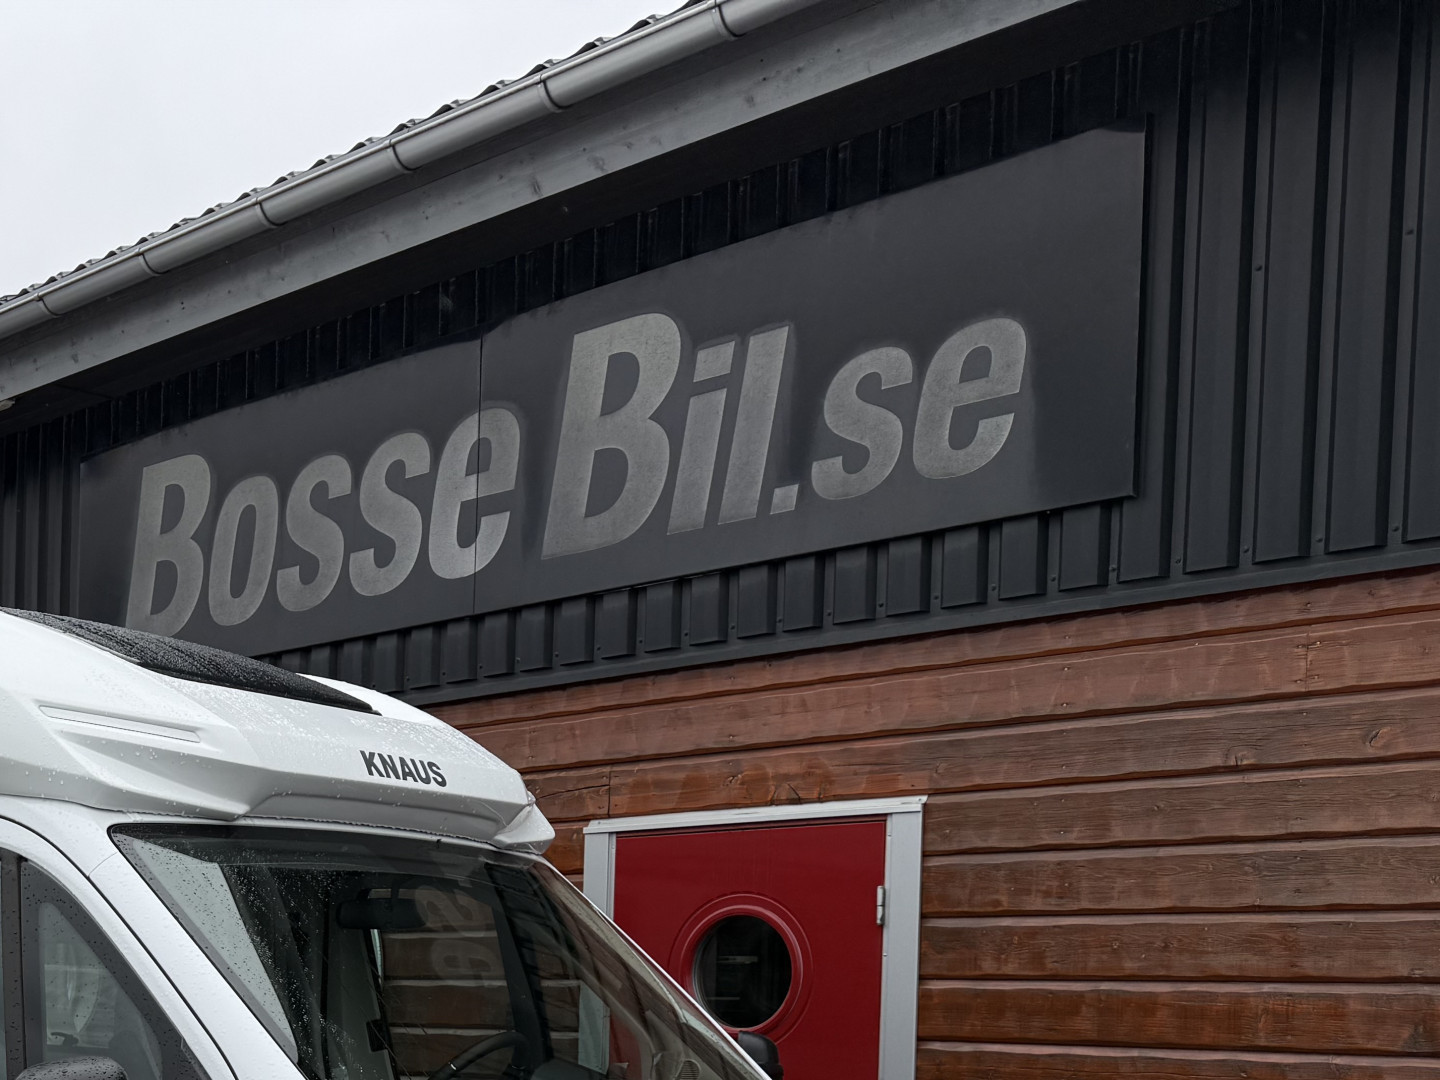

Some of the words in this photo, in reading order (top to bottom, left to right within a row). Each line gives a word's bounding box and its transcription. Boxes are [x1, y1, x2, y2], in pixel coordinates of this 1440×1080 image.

[124, 406, 522, 637] Bosse
[541, 311, 1028, 561] Bil.se
[359, 749, 447, 788] KNAUS
